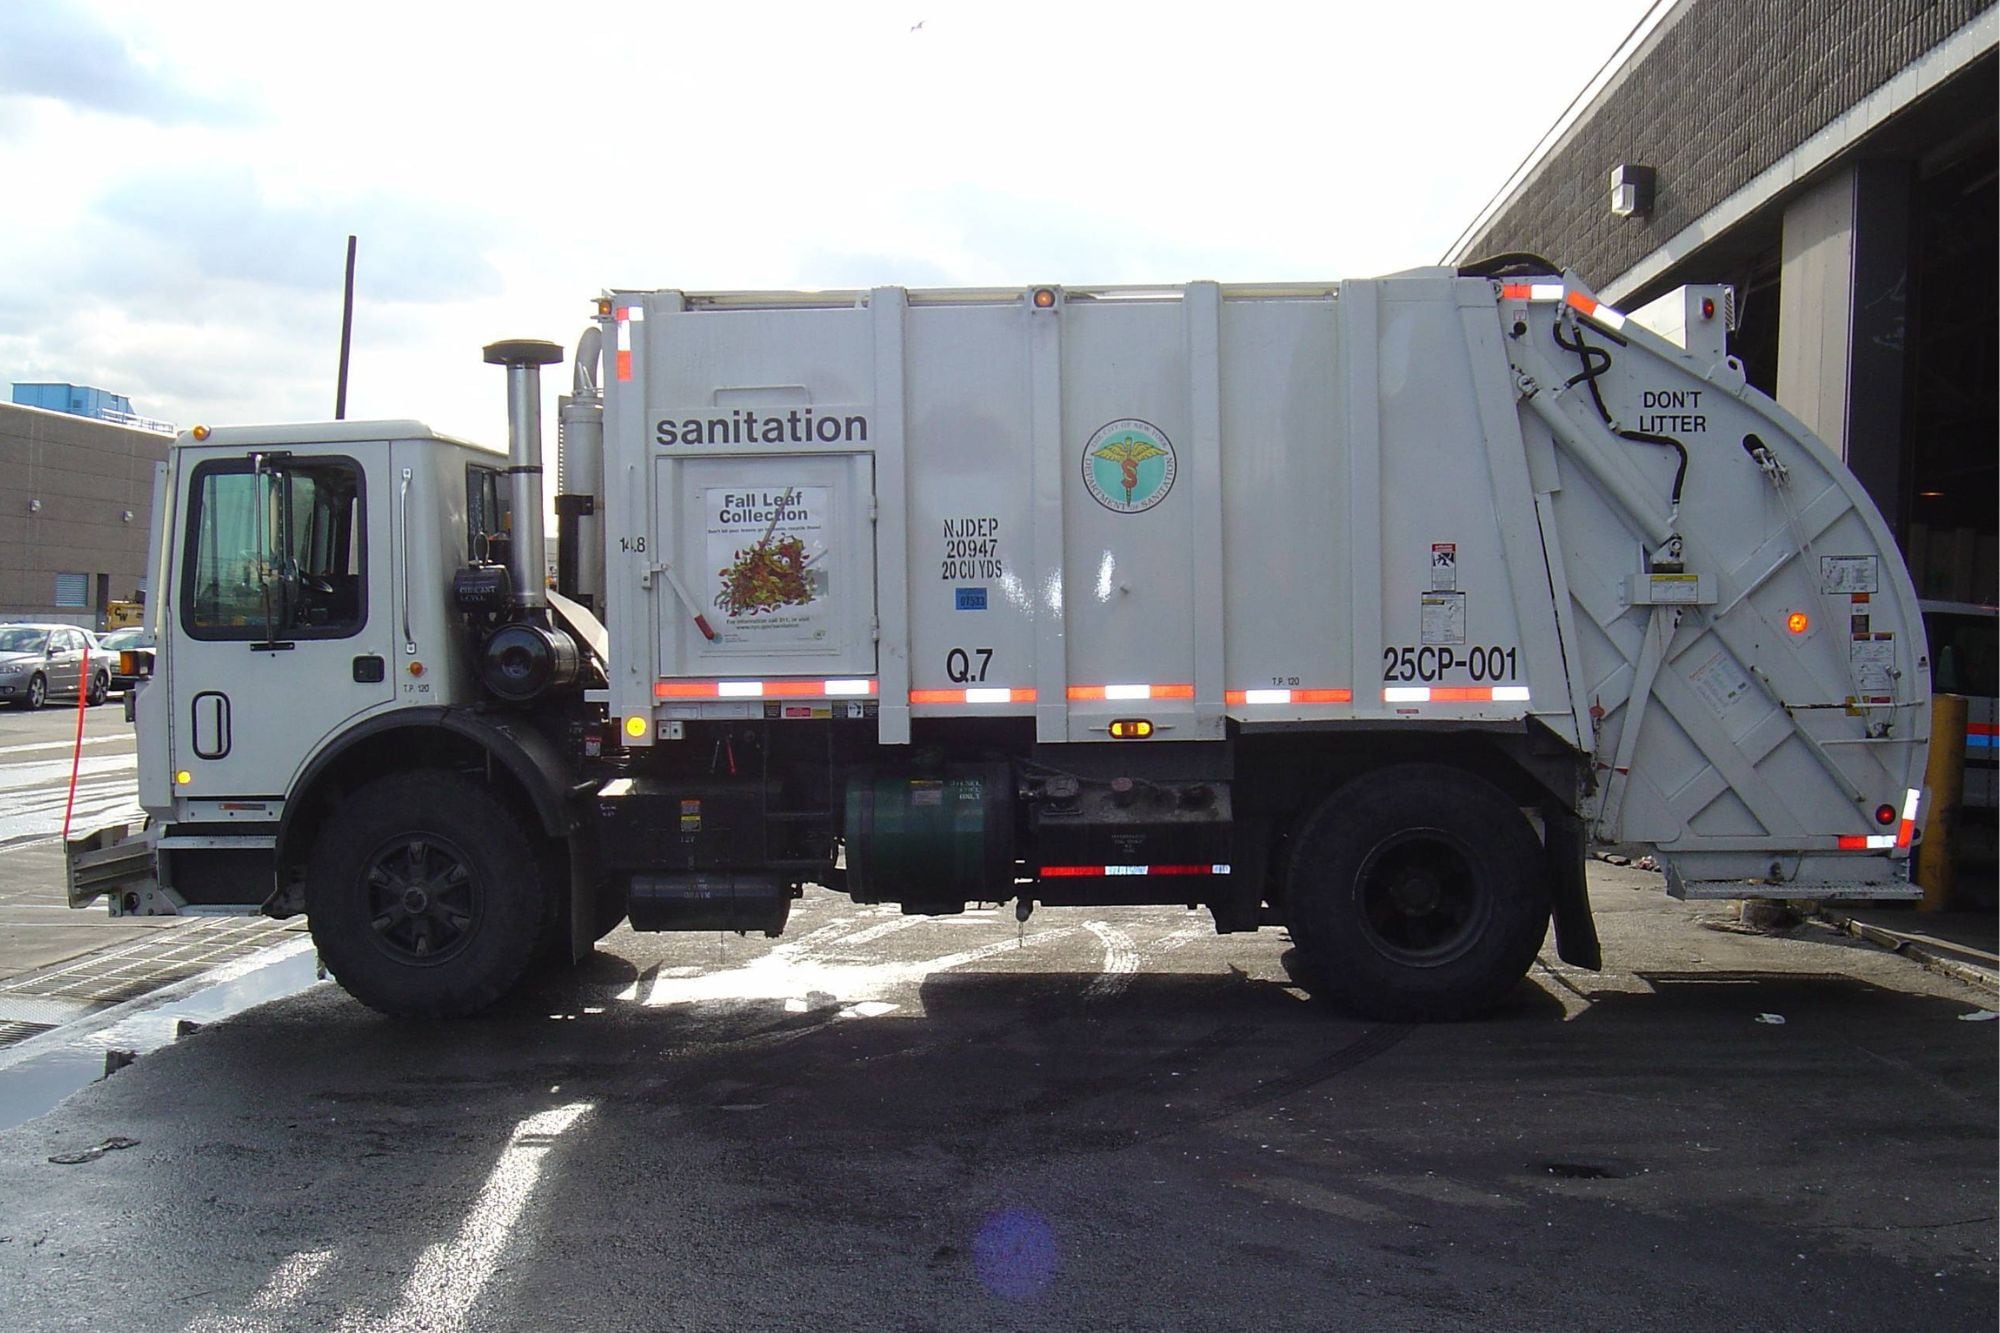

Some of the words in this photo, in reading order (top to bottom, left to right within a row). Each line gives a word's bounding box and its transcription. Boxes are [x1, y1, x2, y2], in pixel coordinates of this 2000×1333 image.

[1643, 391, 1702, 408] DON'T
[656, 408, 867, 446] sanitation
[1639, 415, 1706, 433] LITTER
[1085, 458, 1126, 510] DEPARTMENT
[1140, 457, 1174, 508] SANITATION
[724, 494, 756, 508] Fall
[763, 492, 803, 507] Leaf
[719, 508, 809, 523] Collection
[943, 518, 999, 538] NJDEP
[946, 539, 998, 558] 20947
[942, 561, 957, 580] 20
[959, 560, 975, 579] CU
[979, 559, 1003, 579] YDS
[946, 648, 994, 683] Q.7
[1383, 646, 1517, 682] 25CP-001
